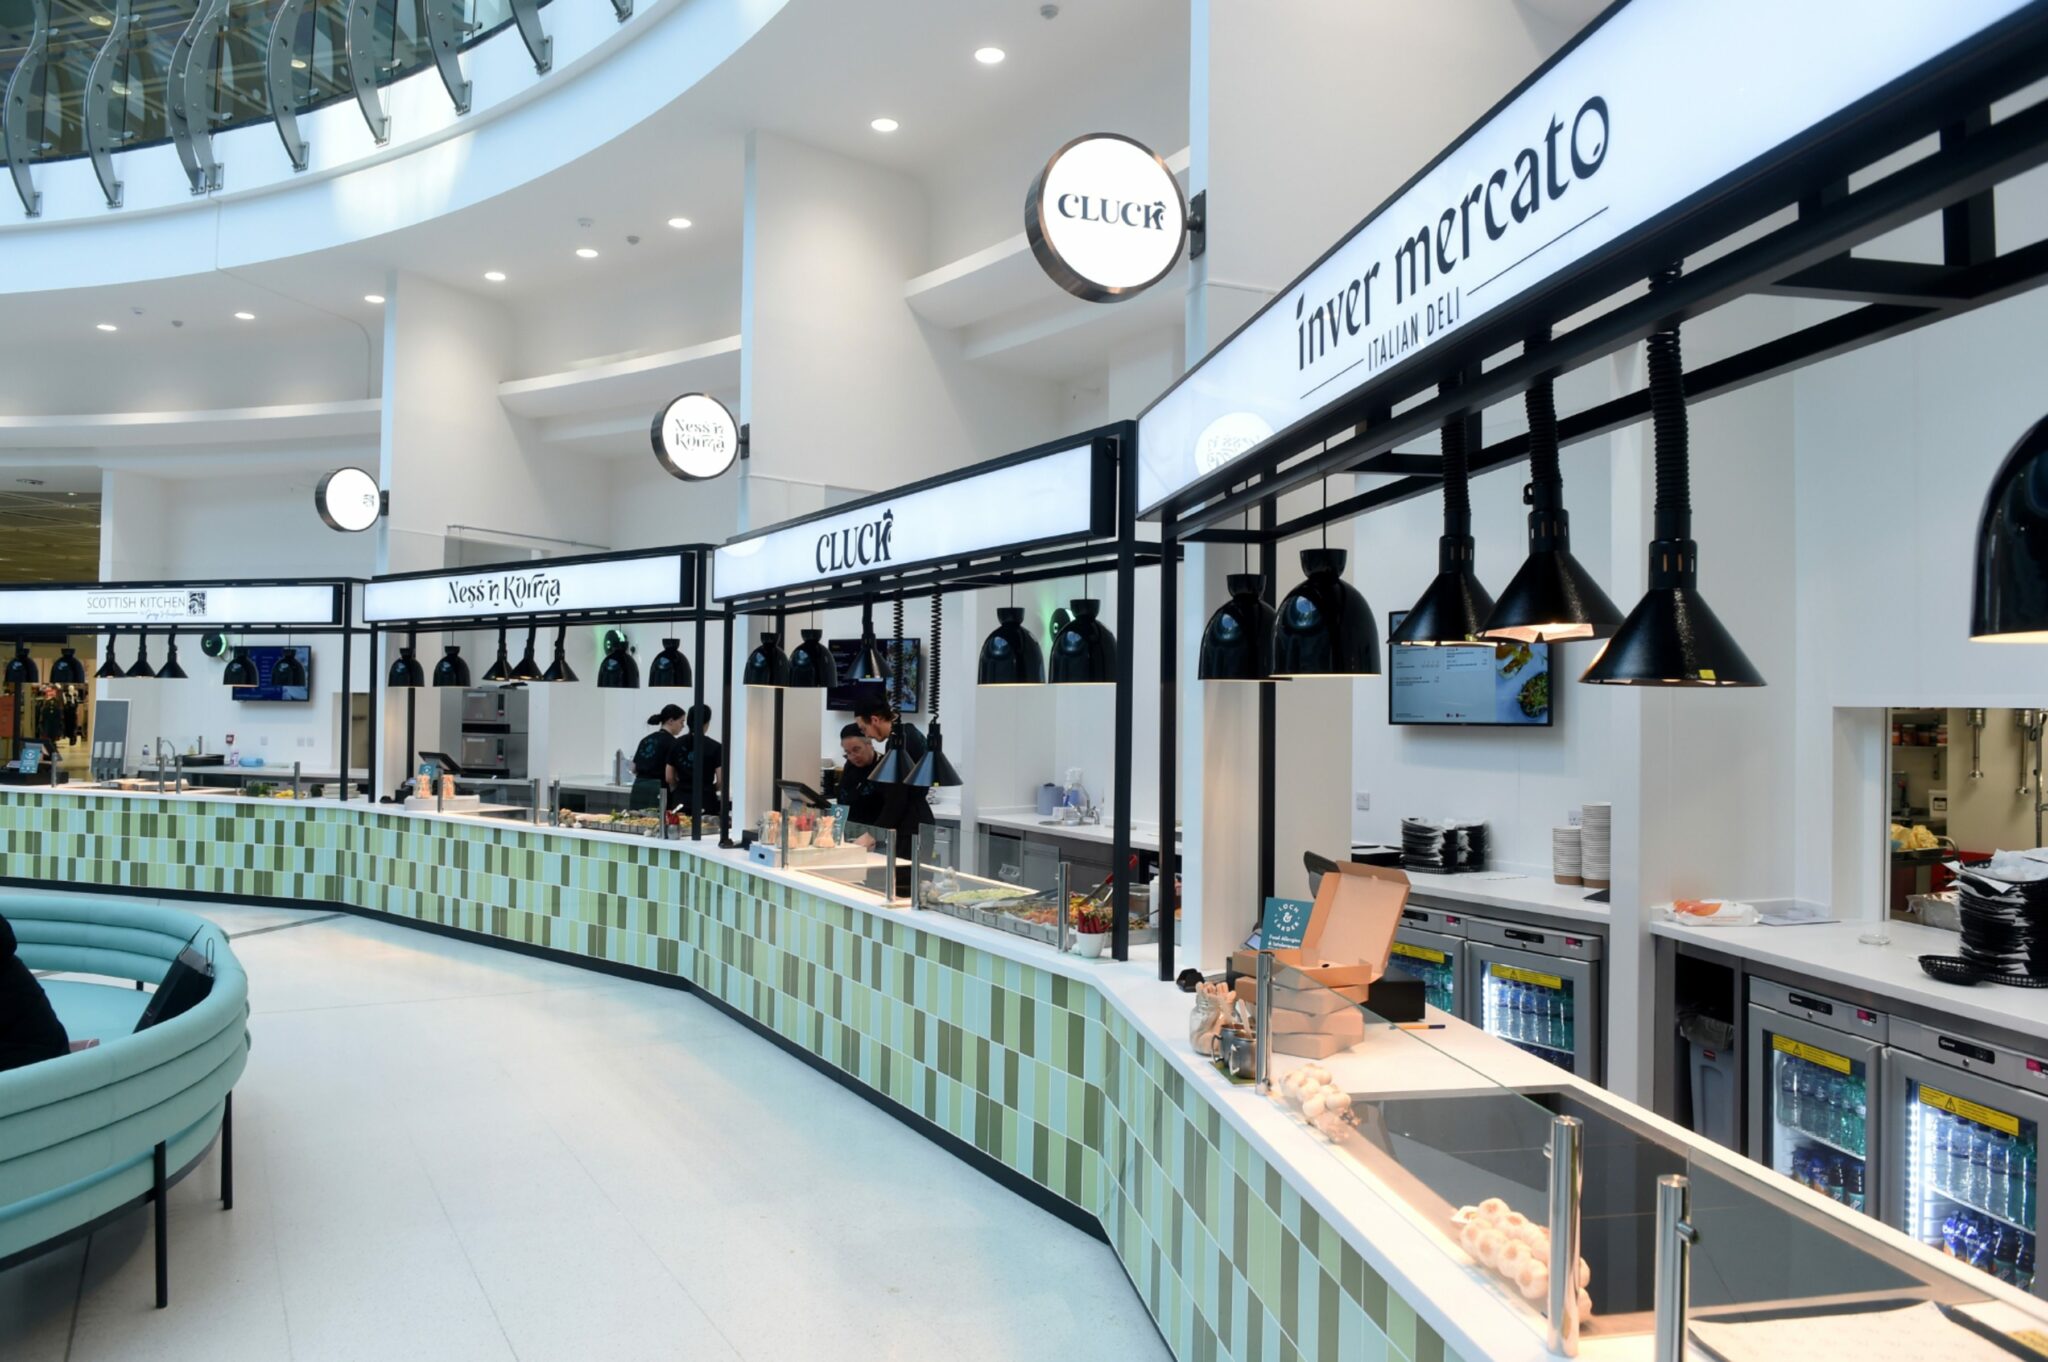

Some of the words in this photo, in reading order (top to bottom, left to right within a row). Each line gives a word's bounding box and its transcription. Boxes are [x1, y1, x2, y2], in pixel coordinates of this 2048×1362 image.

[1057, 193, 1166, 231] CLUCK
[1296, 261, 1381, 371] inver
[1395, 95, 1610, 306] mercato
[1368, 312, 1419, 372] ITALIAN
[1427, 286, 1460, 337] DELI
[816, 508, 893, 574] CLUCK
[87, 596, 137, 609] SCOTTISH
[140, 596, 186, 608] KITCHEN
[504, 573, 561, 608] Korma
